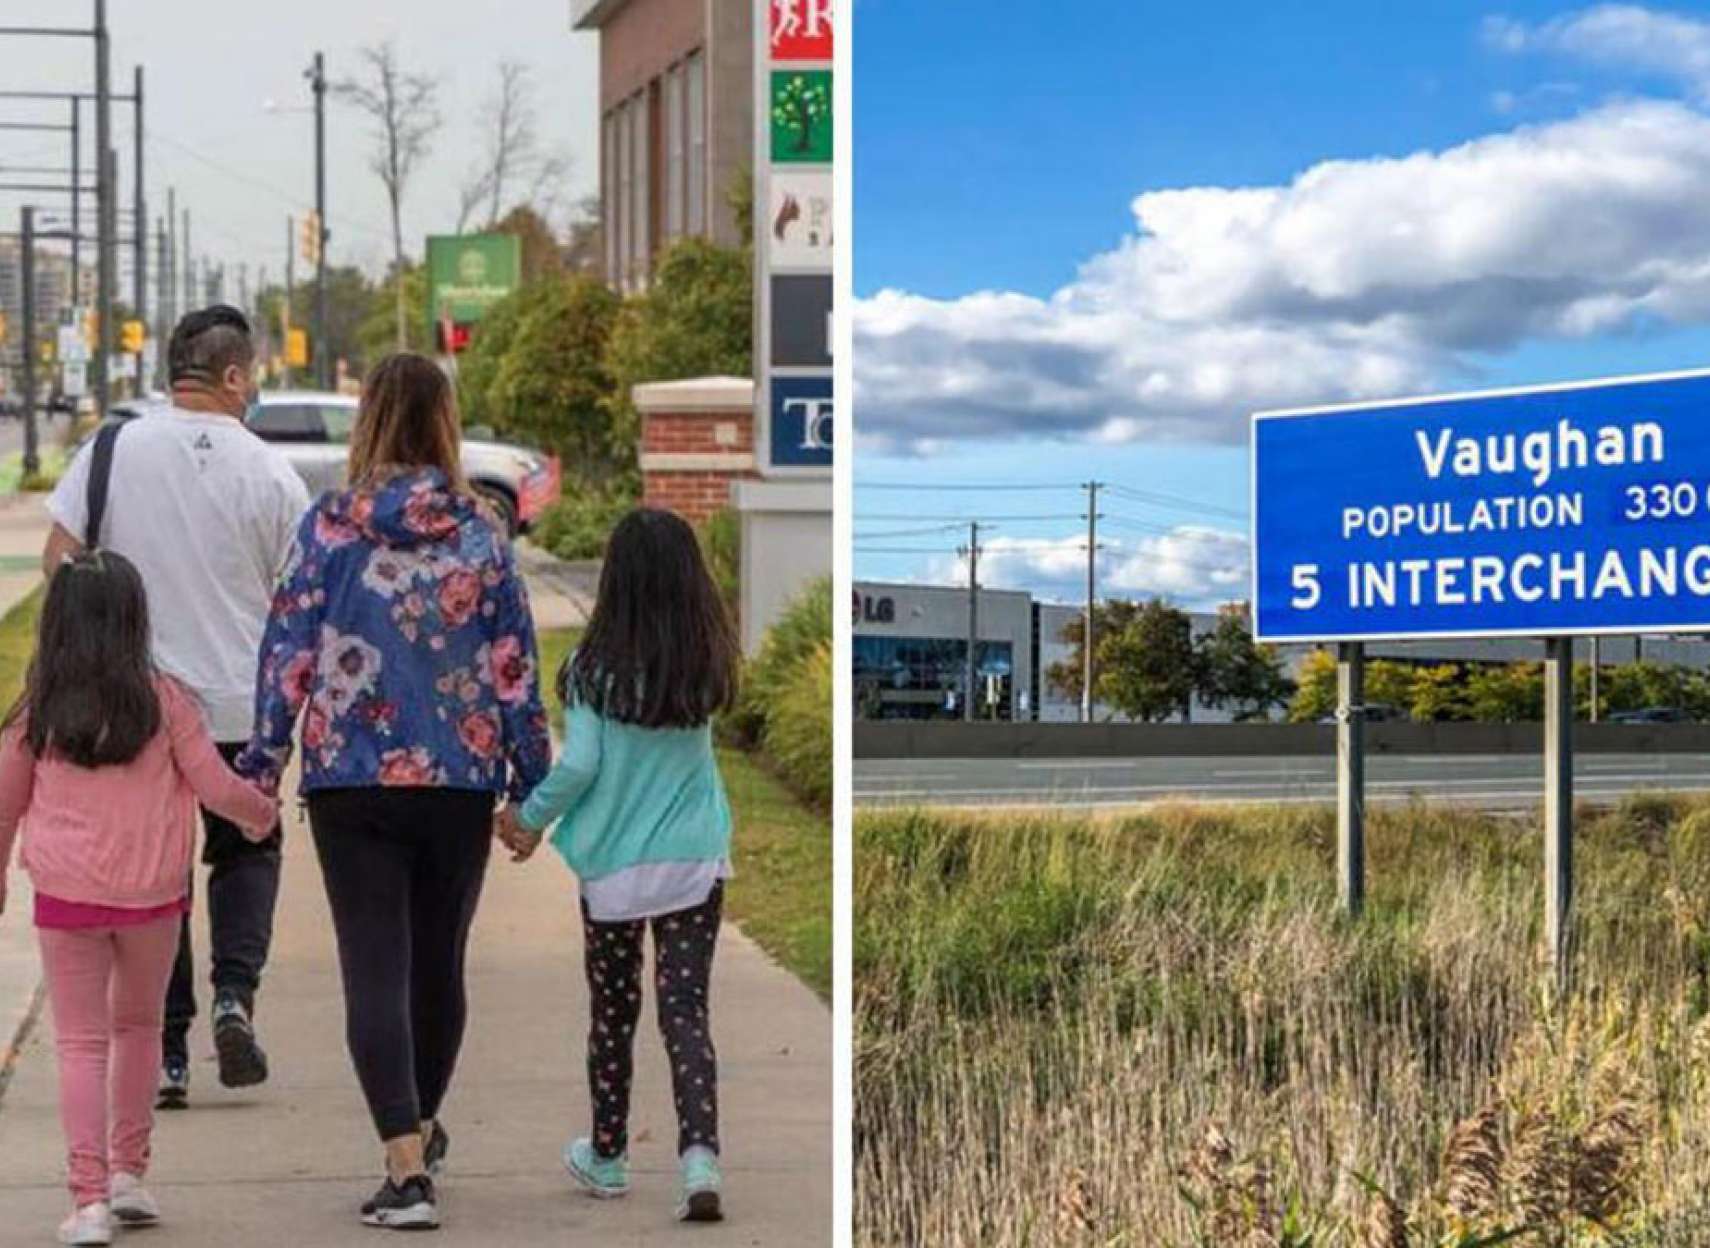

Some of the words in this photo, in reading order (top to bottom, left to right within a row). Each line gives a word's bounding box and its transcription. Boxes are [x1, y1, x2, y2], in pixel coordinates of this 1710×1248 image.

[1415, 418, 1664, 487] Vaughan
[1342, 492, 1584, 539] POPULATION
[1624, 482, 1698, 519] 330
[1290, 562, 1322, 609] 5
[1347, 544, 1710, 608] INTERCHANG
[865, 596, 896, 623] LG
